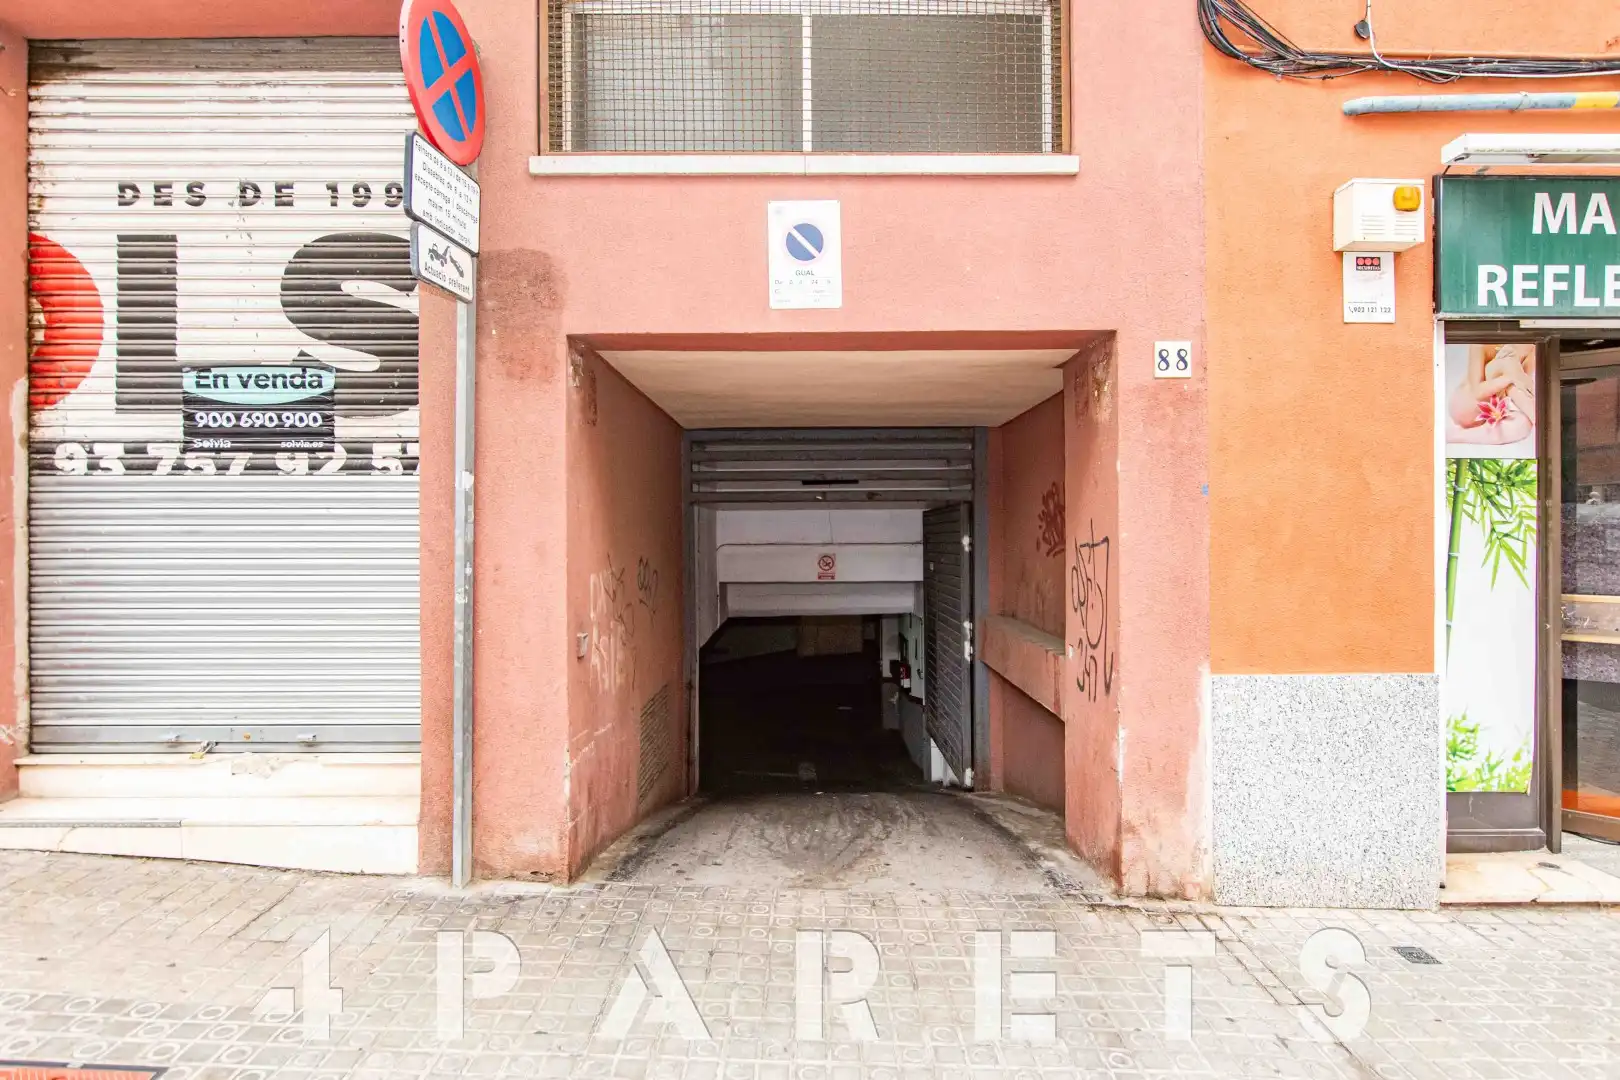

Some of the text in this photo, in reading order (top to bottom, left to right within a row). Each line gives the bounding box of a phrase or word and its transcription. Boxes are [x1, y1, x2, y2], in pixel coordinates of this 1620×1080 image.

[1532, 192, 1617, 234] MA
[1477, 265, 1620, 307] REFLE
[1157, 348, 1189, 372] 88
[194, 367, 323, 389] En venda
[195, 411, 323, 428] 900 690 900
[194, 438, 231, 449] Solvia
[280, 439, 324, 448] solvia.es
